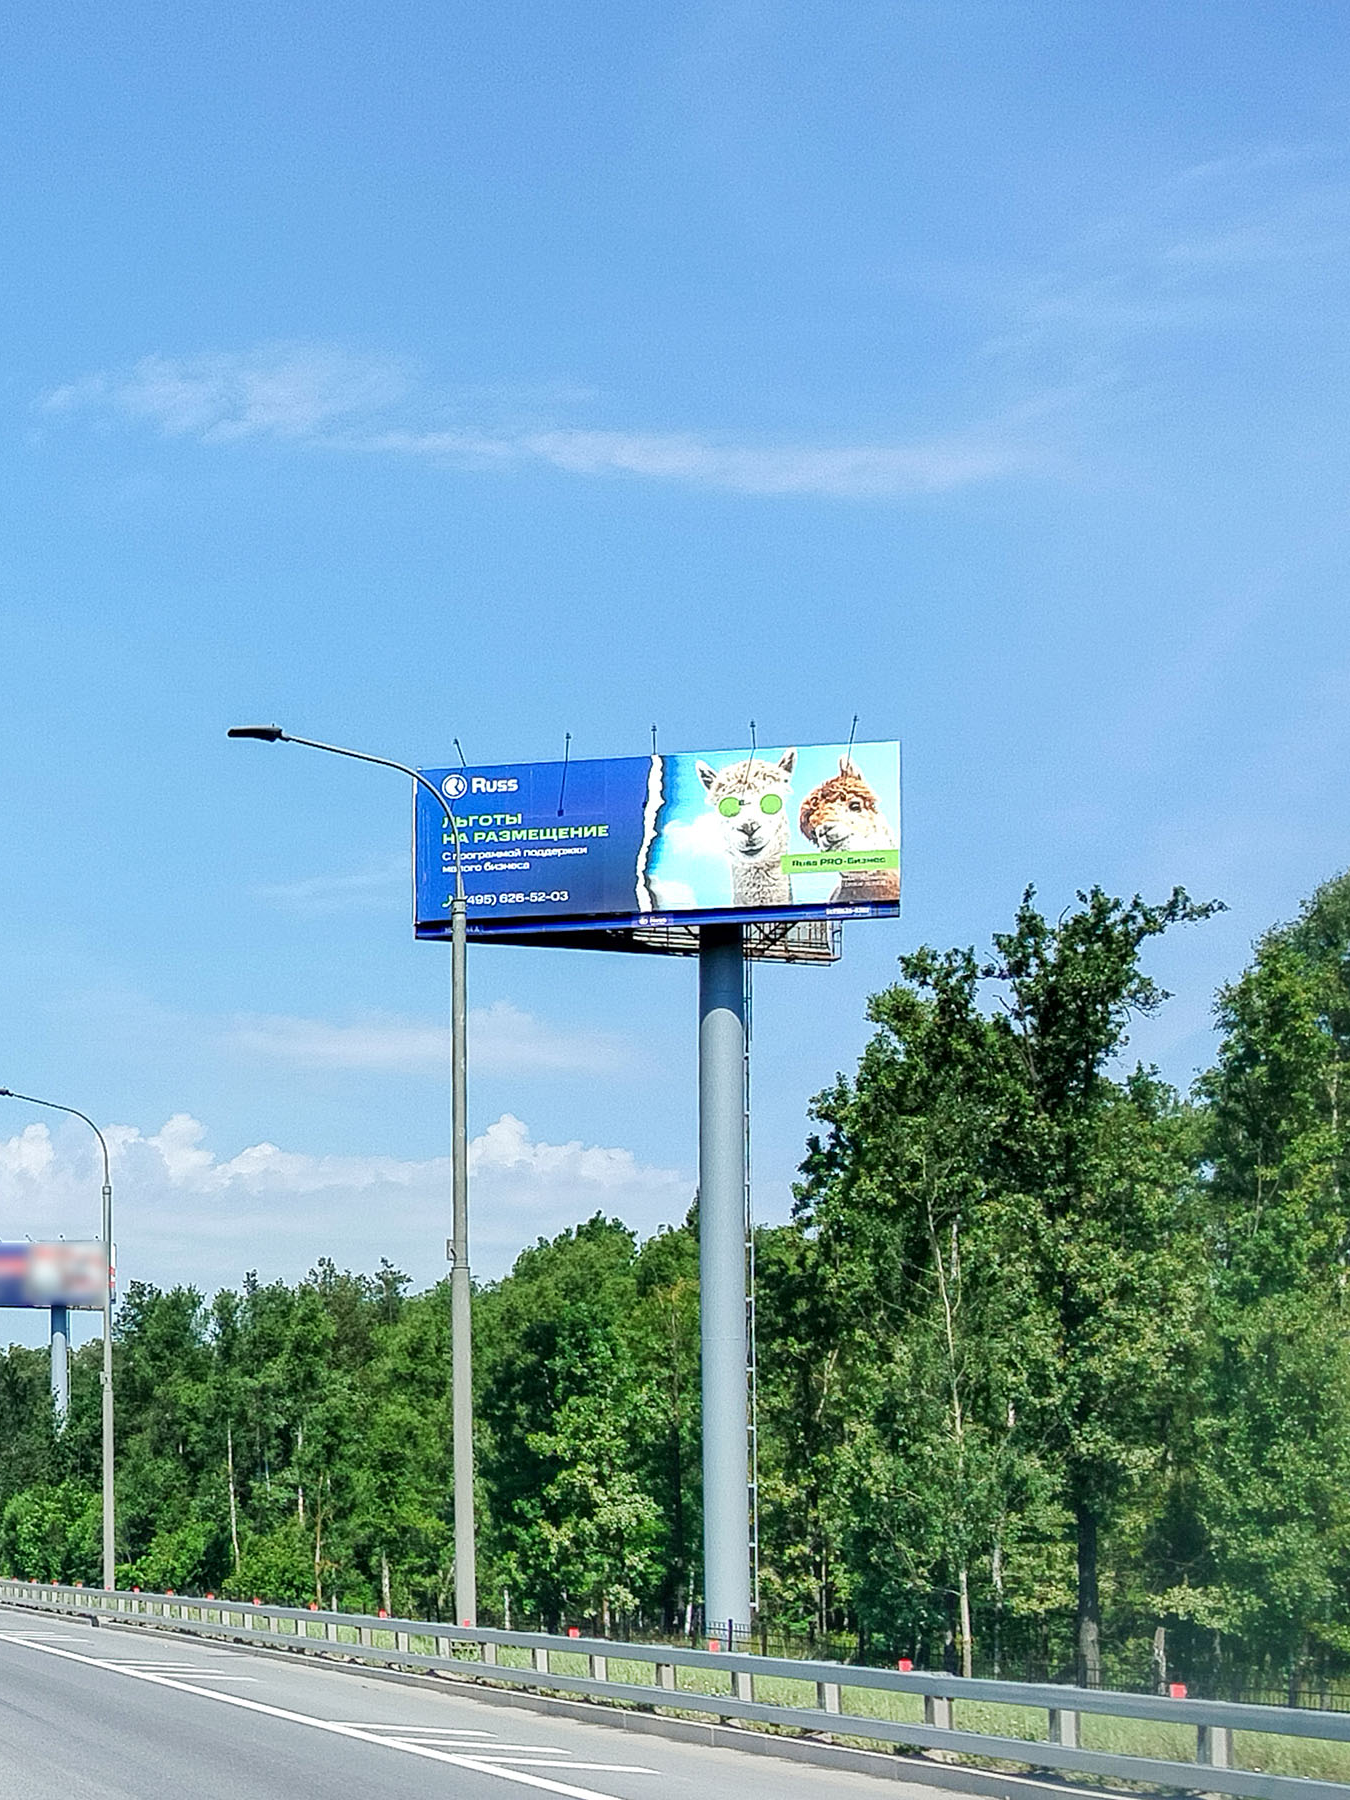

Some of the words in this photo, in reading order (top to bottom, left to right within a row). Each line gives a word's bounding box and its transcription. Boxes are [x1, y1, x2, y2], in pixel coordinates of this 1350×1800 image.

[471, 777, 519, 794] Russ
[442, 833, 470, 845] НА
[473, 825, 610, 843] РАЗМЕЩЕНИЕ
[498, 891, 569, 903] 626-52-03
